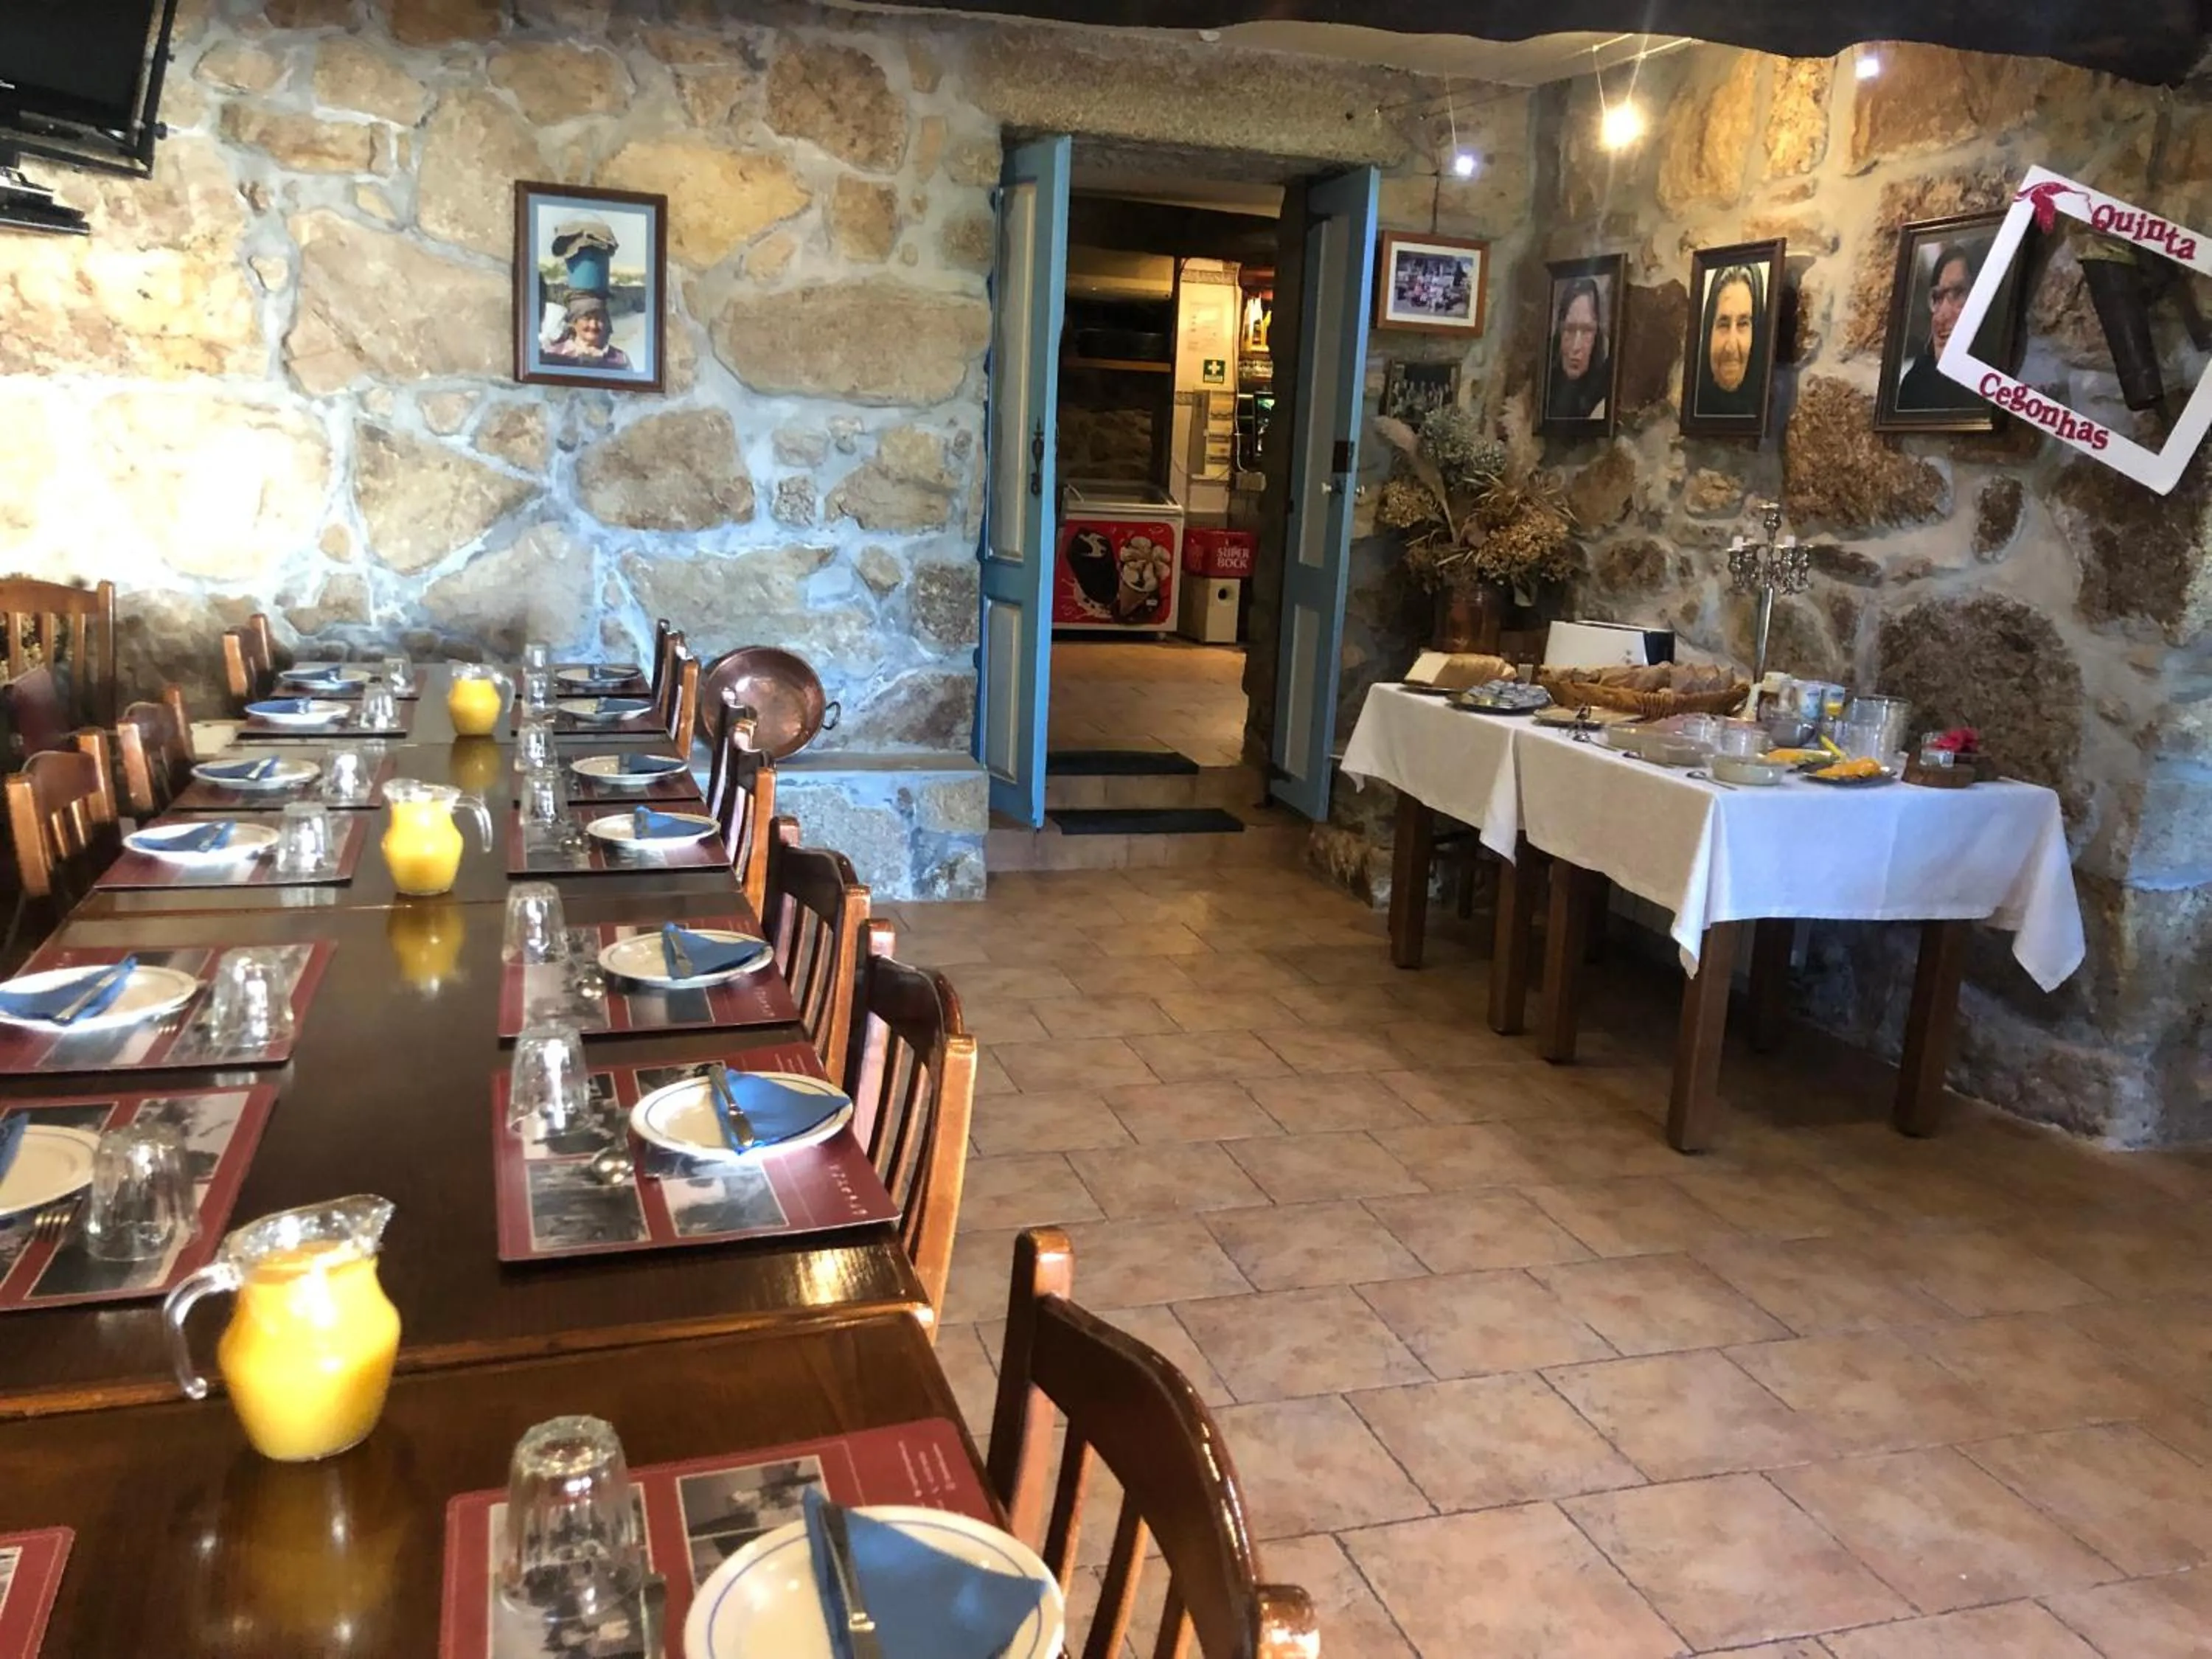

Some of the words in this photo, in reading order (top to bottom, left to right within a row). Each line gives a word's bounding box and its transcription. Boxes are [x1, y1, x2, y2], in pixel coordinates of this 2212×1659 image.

[2091, 204, 2196, 260] Quinta
[1979, 372, 2110, 450] Cegonhas
[1217, 546, 1250, 558] SUPER
[1217, 557, 1248, 568] BOCK
